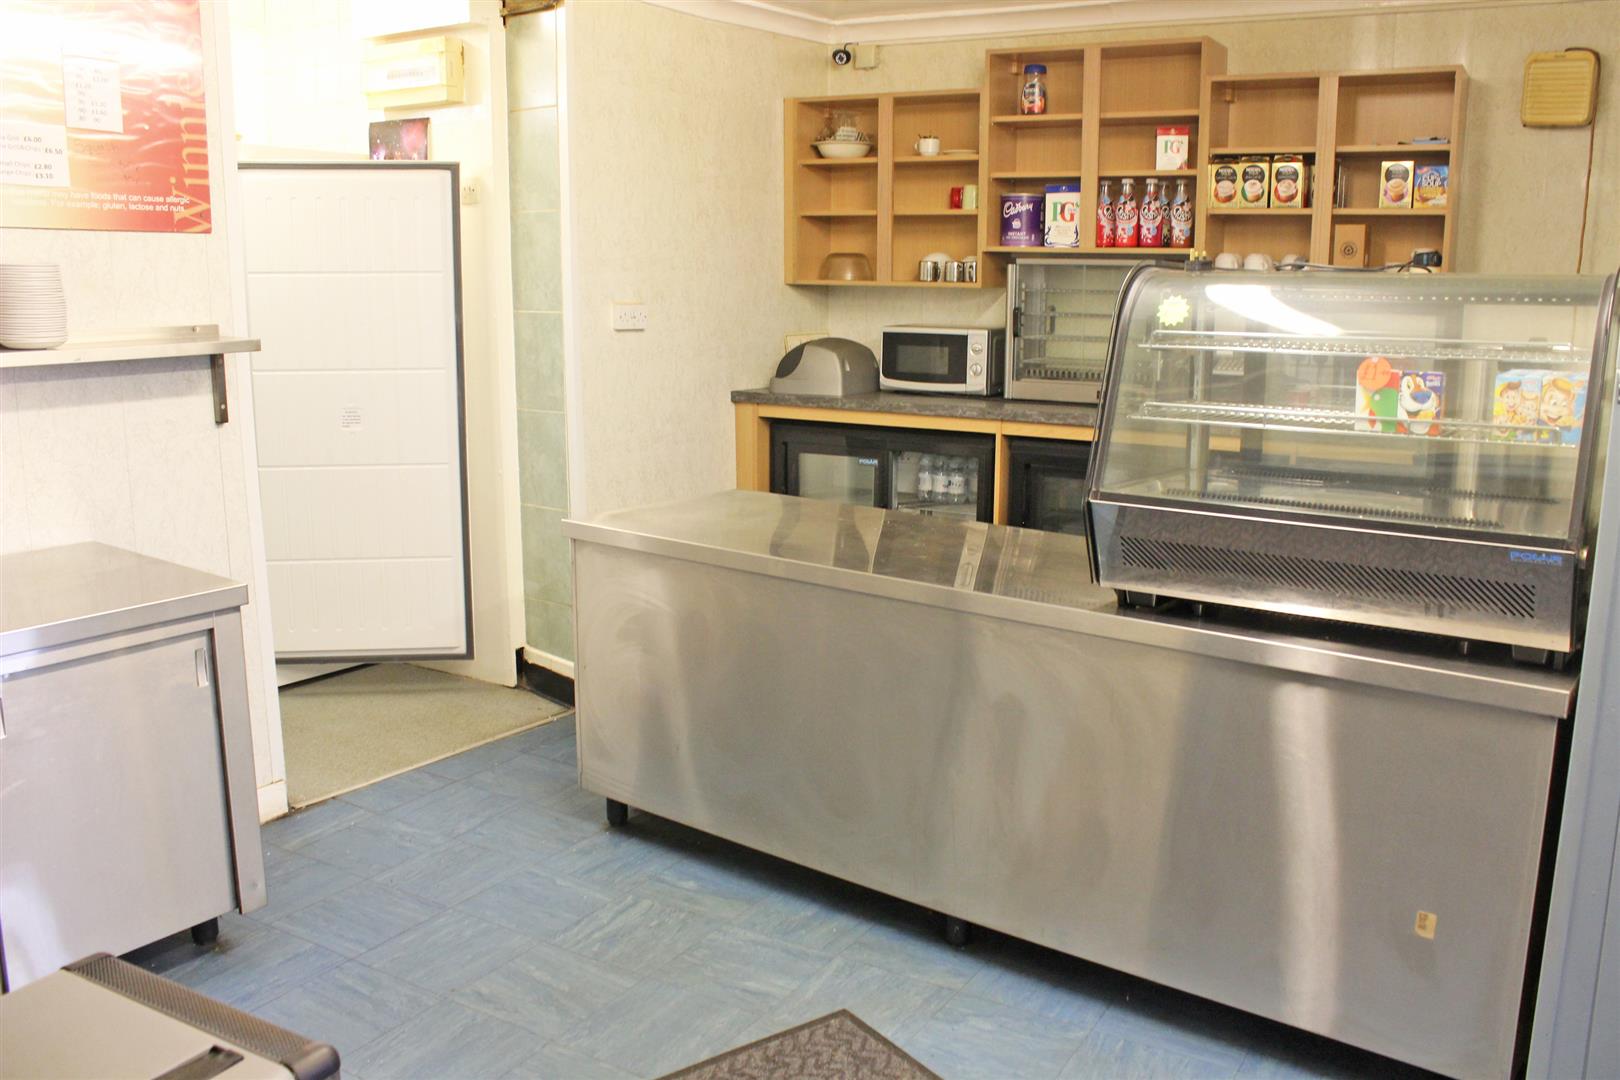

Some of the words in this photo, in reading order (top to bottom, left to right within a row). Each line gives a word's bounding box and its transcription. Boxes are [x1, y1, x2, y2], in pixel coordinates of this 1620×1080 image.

[24, 136, 42, 144] £6.00
[45, 147, 63, 155] £6.50
[91, 192, 111, 200] foods
[113, 193, 127, 201] that
[128, 194, 142, 202] can
[165, 196, 190, 205] allergic
[128, 203, 153, 211] lactose
[1003, 201, 1034, 219] Cadbury
[1052, 201, 1075, 223] PG
[1510, 550, 1563, 567] POLAR
